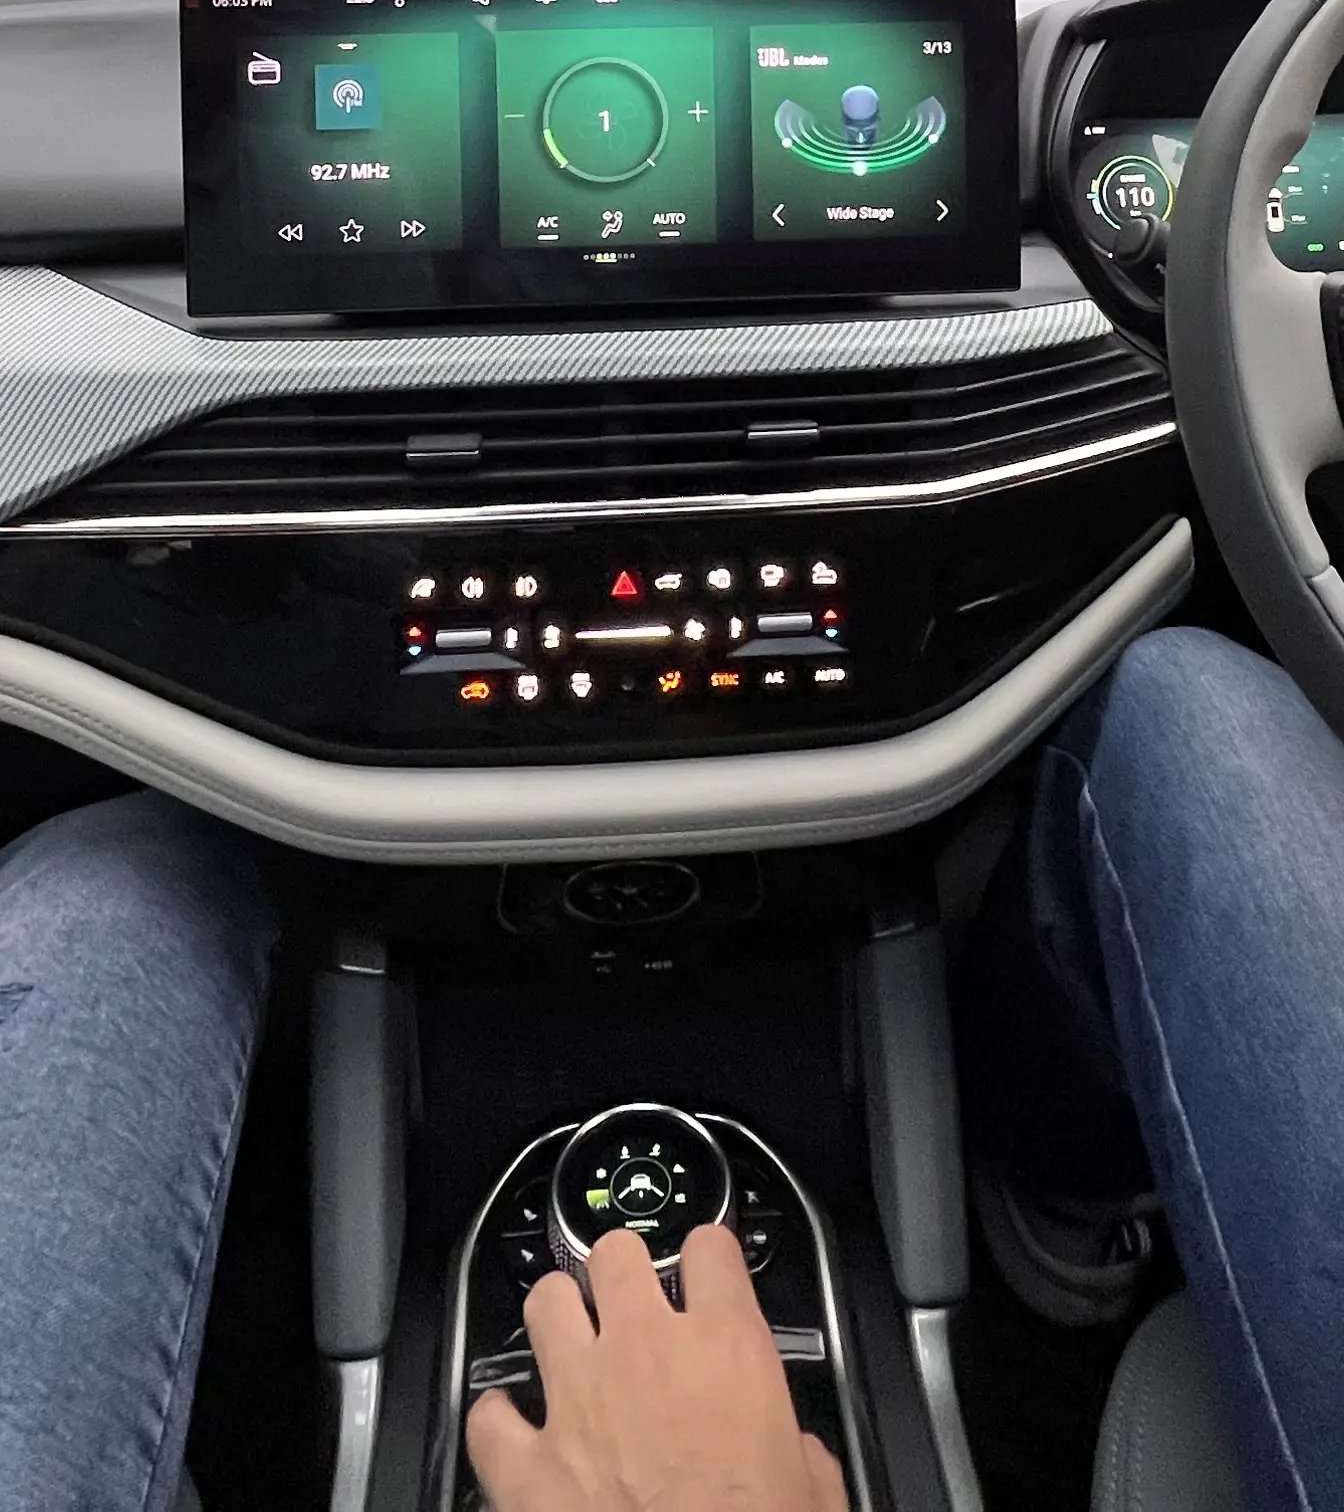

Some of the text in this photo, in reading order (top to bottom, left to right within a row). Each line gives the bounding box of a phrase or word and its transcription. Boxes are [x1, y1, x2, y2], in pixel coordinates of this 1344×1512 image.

[922, 41, 952, 54] 3/13
[598, 110, 610, 132] 1
[310, 162, 391, 181] 92.7 MHz
[1115, 186, 1155, 208] 110
[652, 213, 686, 225] AUTO
[827, 206, 895, 222] Wide Stage
[537, 216, 559, 228] A/C
[711, 672, 739, 687] SYNC
